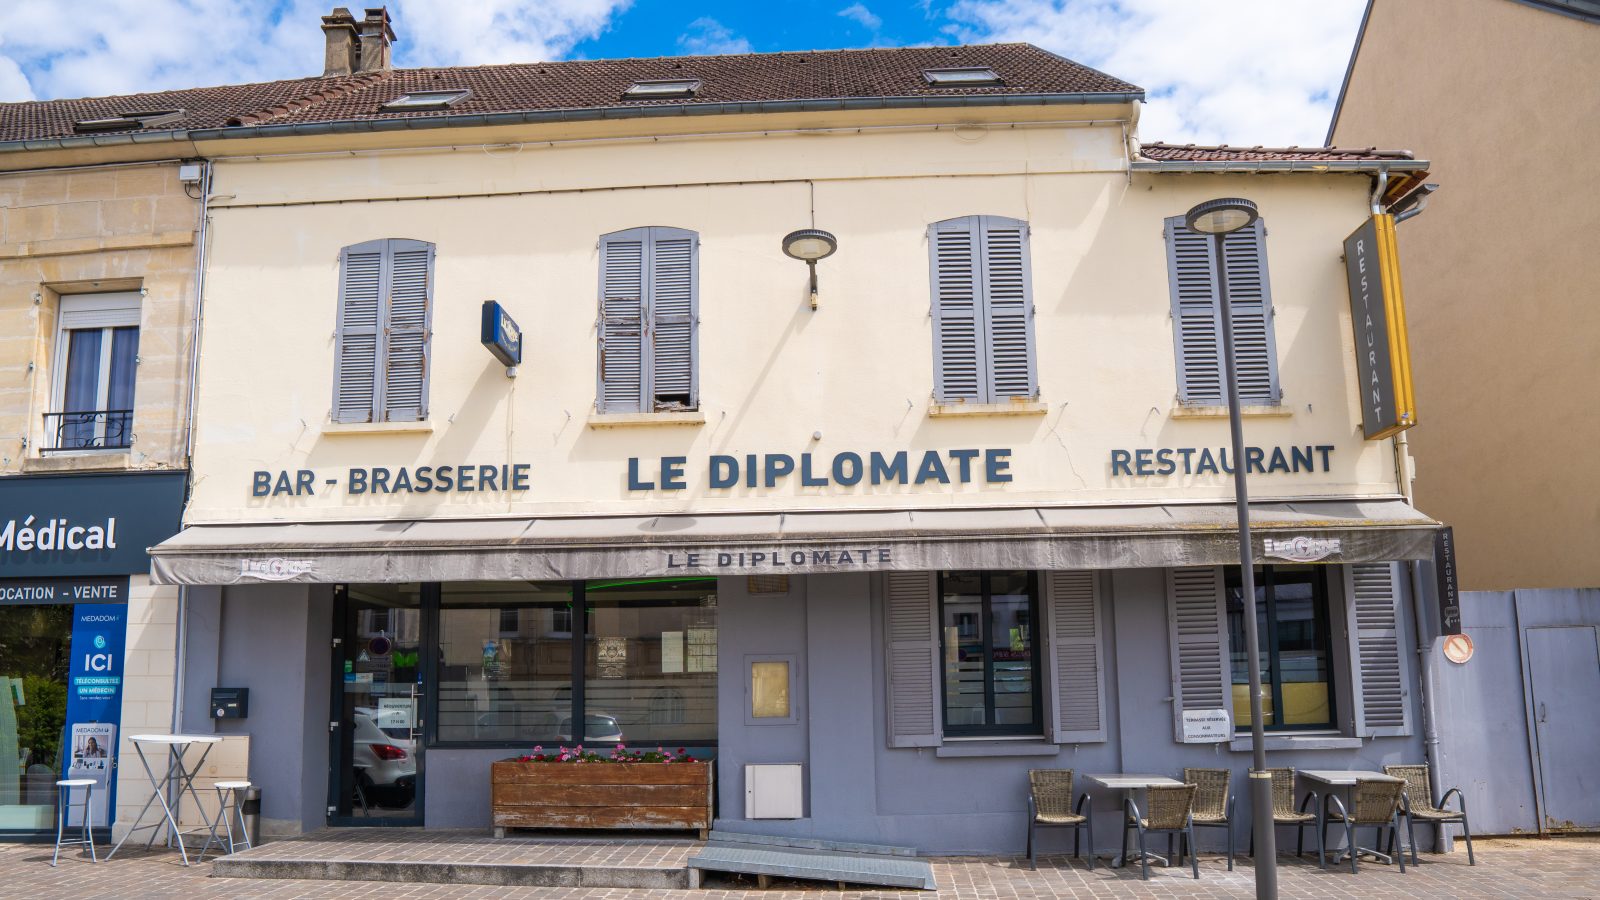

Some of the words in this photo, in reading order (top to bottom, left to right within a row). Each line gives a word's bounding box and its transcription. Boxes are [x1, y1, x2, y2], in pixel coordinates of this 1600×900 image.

[1356, 239, 1382, 424] RESTAURANT
[627, 455, 687, 491] LE
[709, 448, 1013, 489] DIPLOMATE
[1110, 445, 1335, 477] RESTAURANT
[252, 469, 315, 497] BAR
[348, 463, 531, 495] BRASSERIE
[0, 514, 117, 552] Médical
[667, 553, 700, 569] LE
[717, 548, 892, 568] DIPLOMATE
[1442, 533, 1454, 605] RESTAURANT
[73, 585, 118, 599] VENTE
[84, 653, 113, 672] ICI
